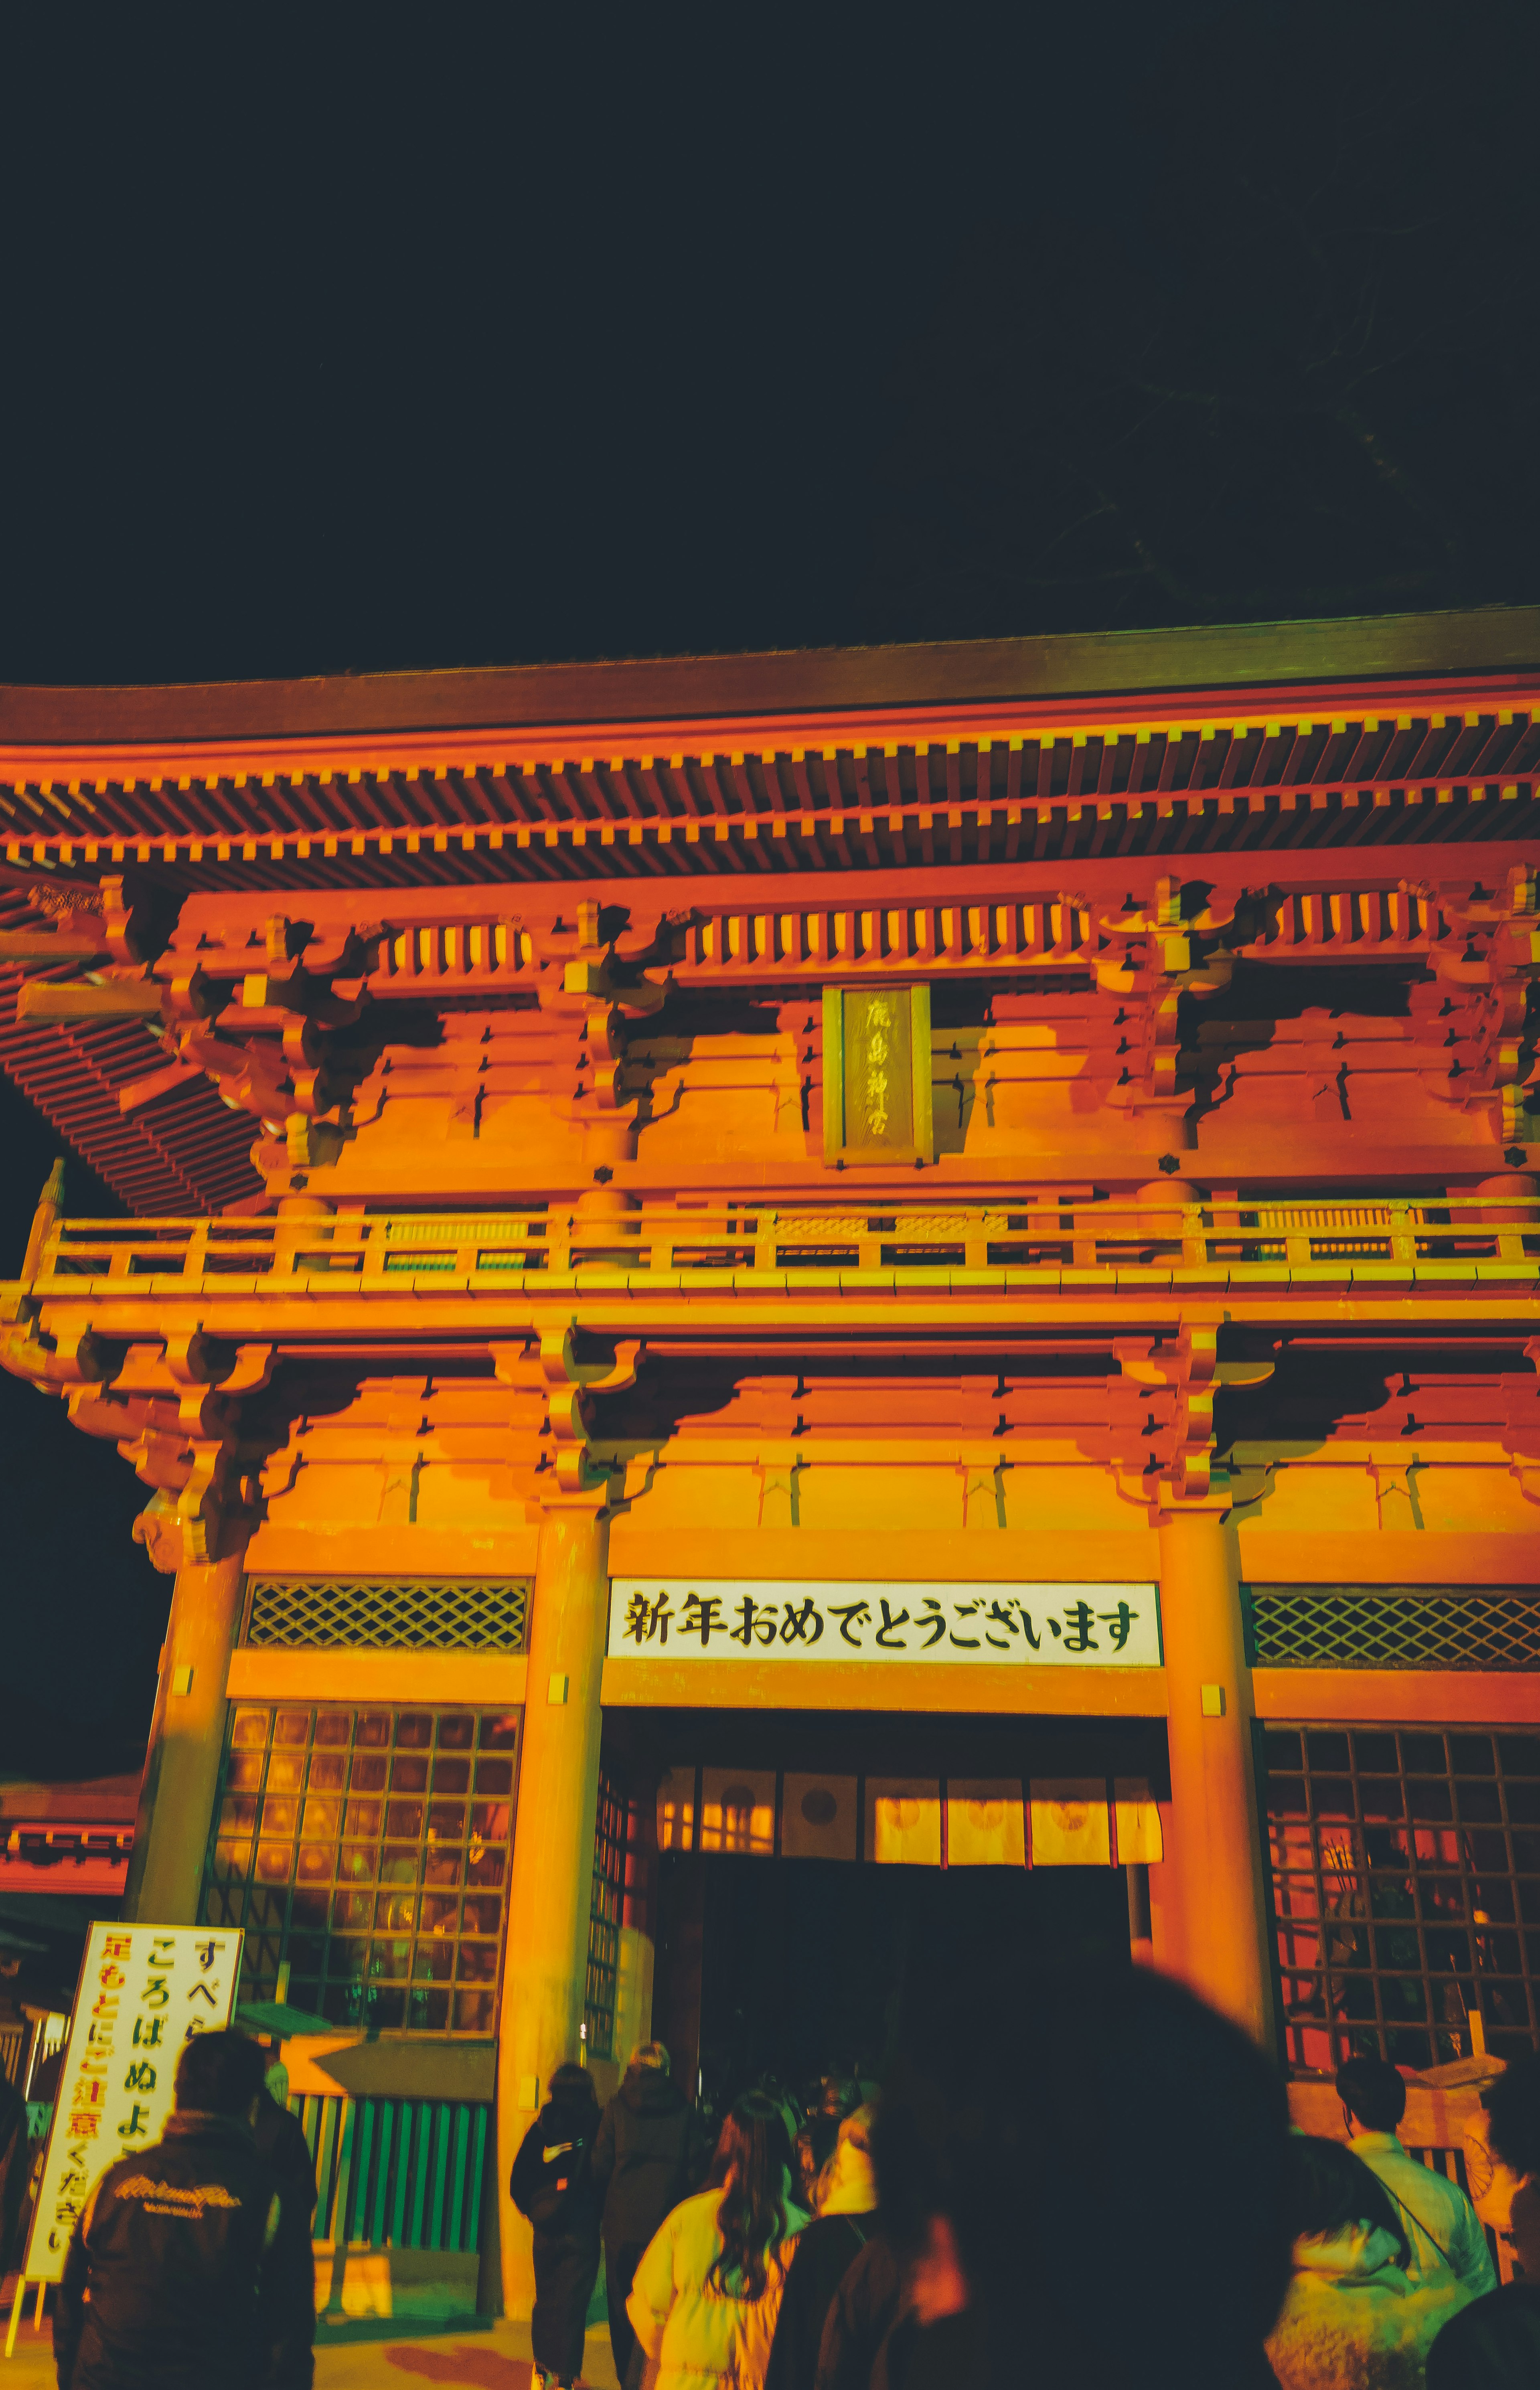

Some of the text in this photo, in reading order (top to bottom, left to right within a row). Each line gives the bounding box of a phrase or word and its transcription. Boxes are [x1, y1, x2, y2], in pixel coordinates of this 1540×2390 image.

[622, 1590, 1140, 1653] 新年おめでとうございます
